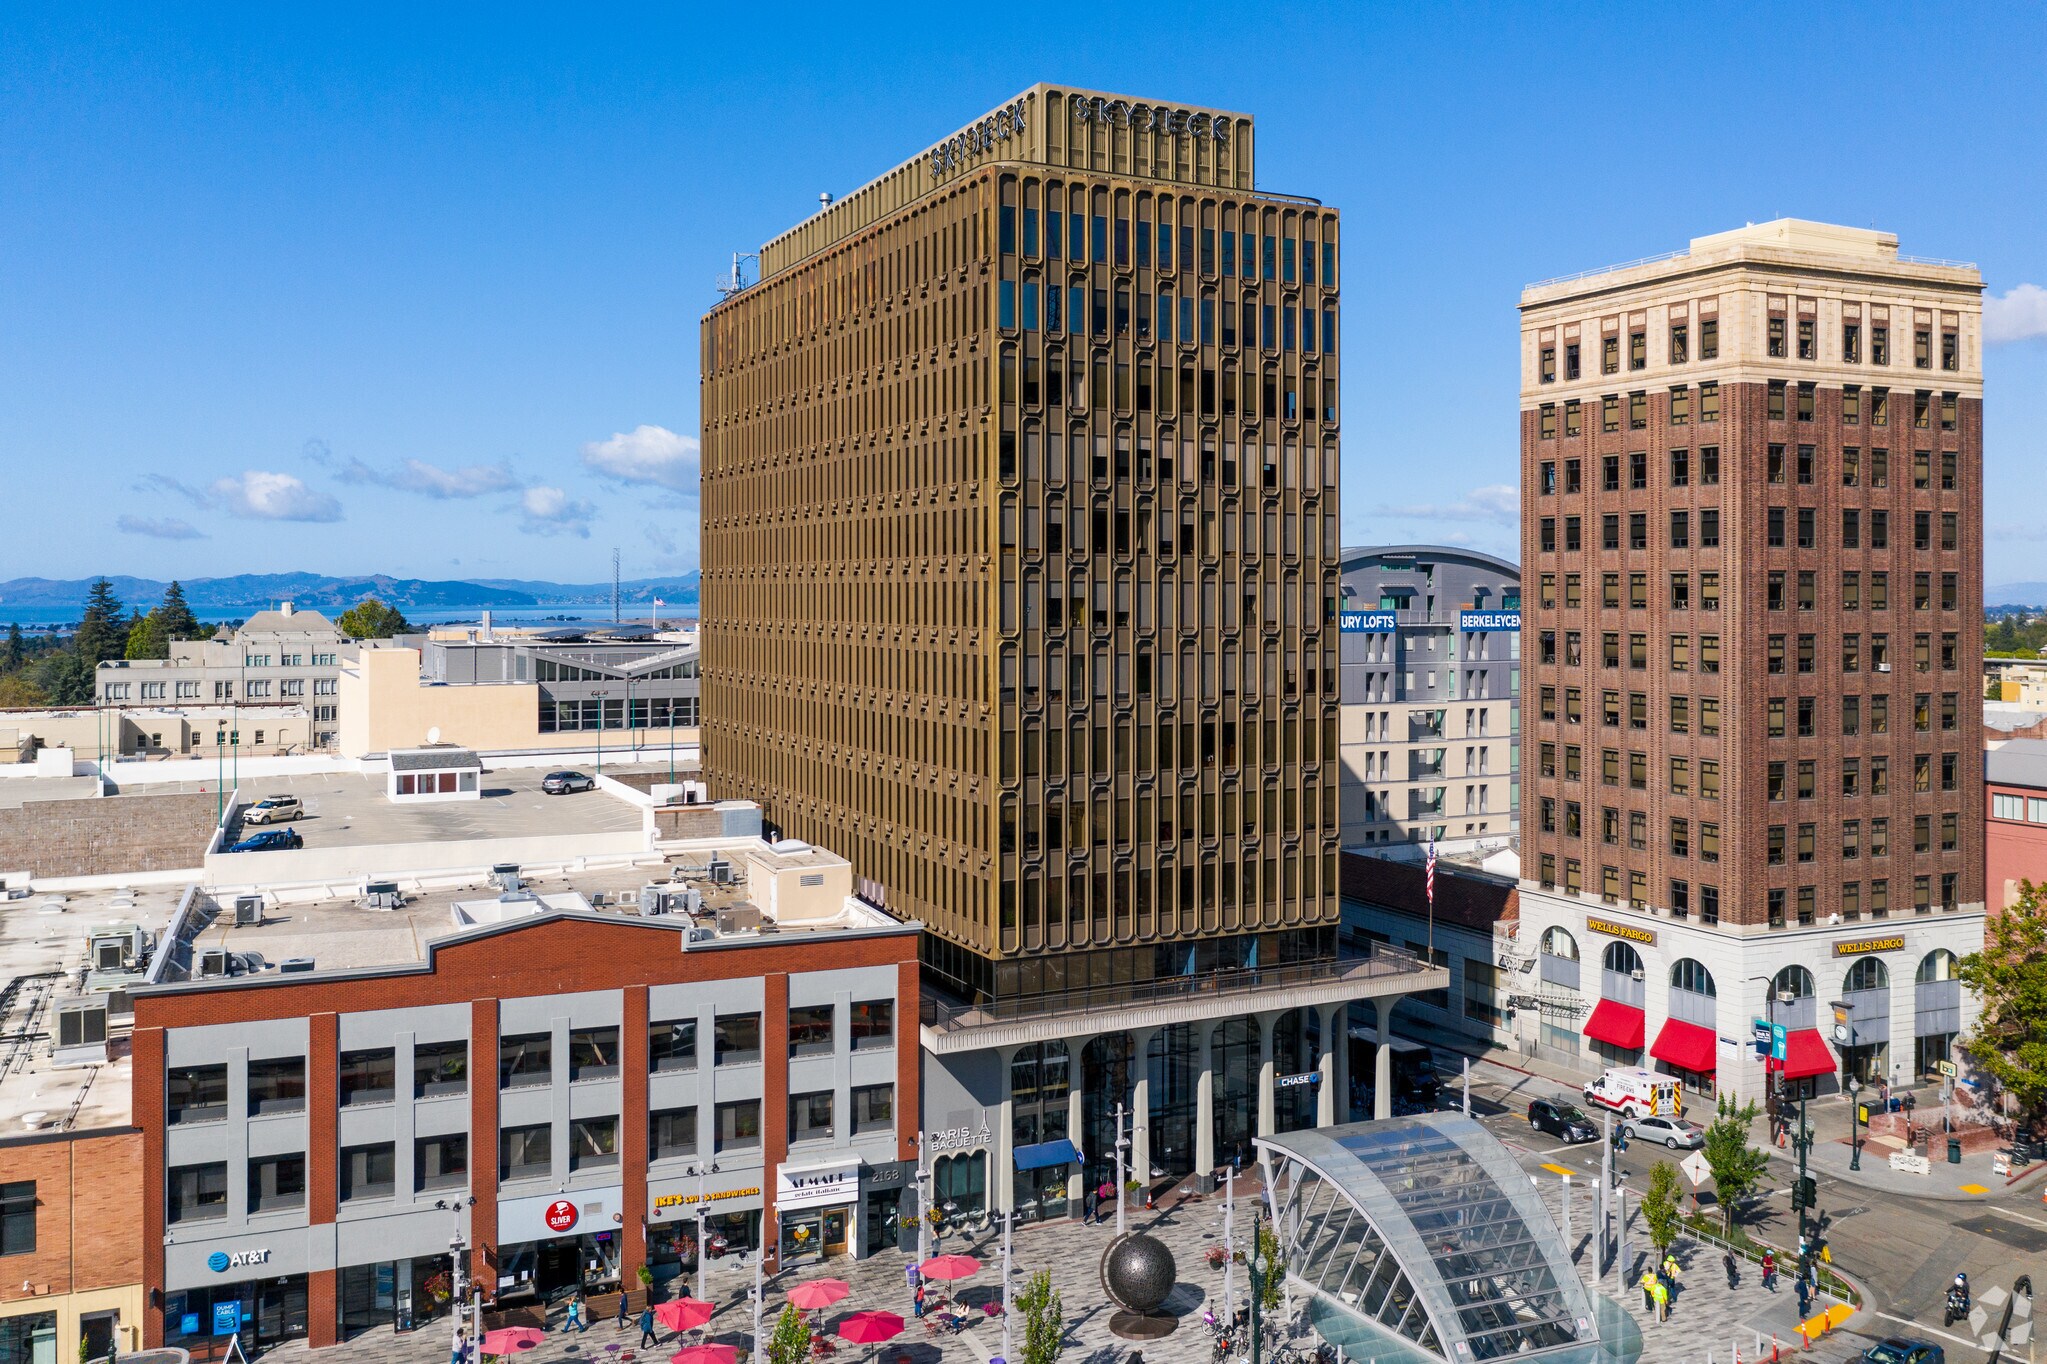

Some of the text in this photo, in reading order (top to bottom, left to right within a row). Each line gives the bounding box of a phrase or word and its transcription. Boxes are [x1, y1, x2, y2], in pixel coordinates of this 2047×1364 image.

[1341, 615, 1395, 628] URY LOFTS
[1589, 919, 1652, 943] WELLS FARGO
[1837, 938, 1904, 955] WELLS FARGO
[1281, 1075, 1310, 1087] CHASE
[931, 1134, 992, 1151] BAGUETTE
[872, 1169, 901, 1183] 2168
[655, 1194, 684, 1207] IKE'S
[685, 1195, 700, 1204] LOV
[711, 1187, 760, 1201] SANDWICHES
[550, 1214, 571, 1225] SLIVER
[230, 1248, 270, 1267] AT&T
